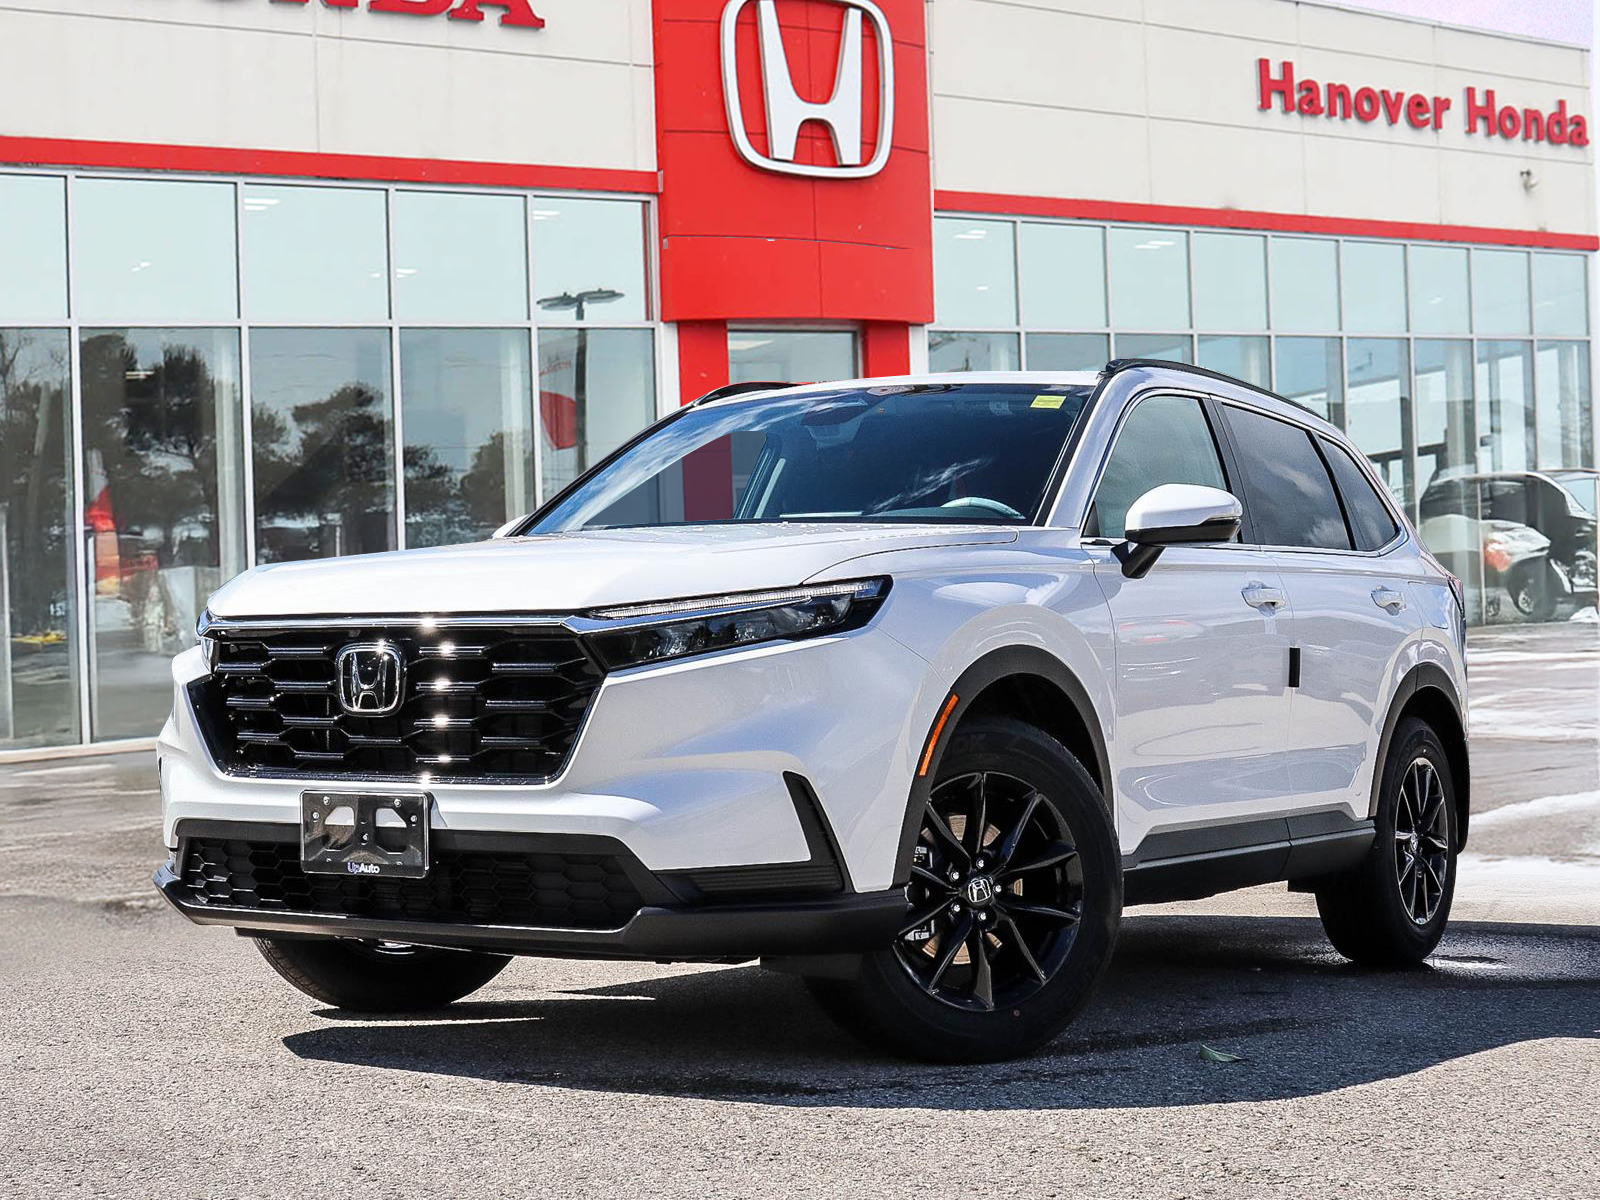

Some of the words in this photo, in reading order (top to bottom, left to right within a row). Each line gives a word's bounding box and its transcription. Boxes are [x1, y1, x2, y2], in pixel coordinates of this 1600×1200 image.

[1257, 57, 1452, 130] Hanover
[1465, 86, 1590, 147] Honda
[347, 861, 380, 874] UpAuto
